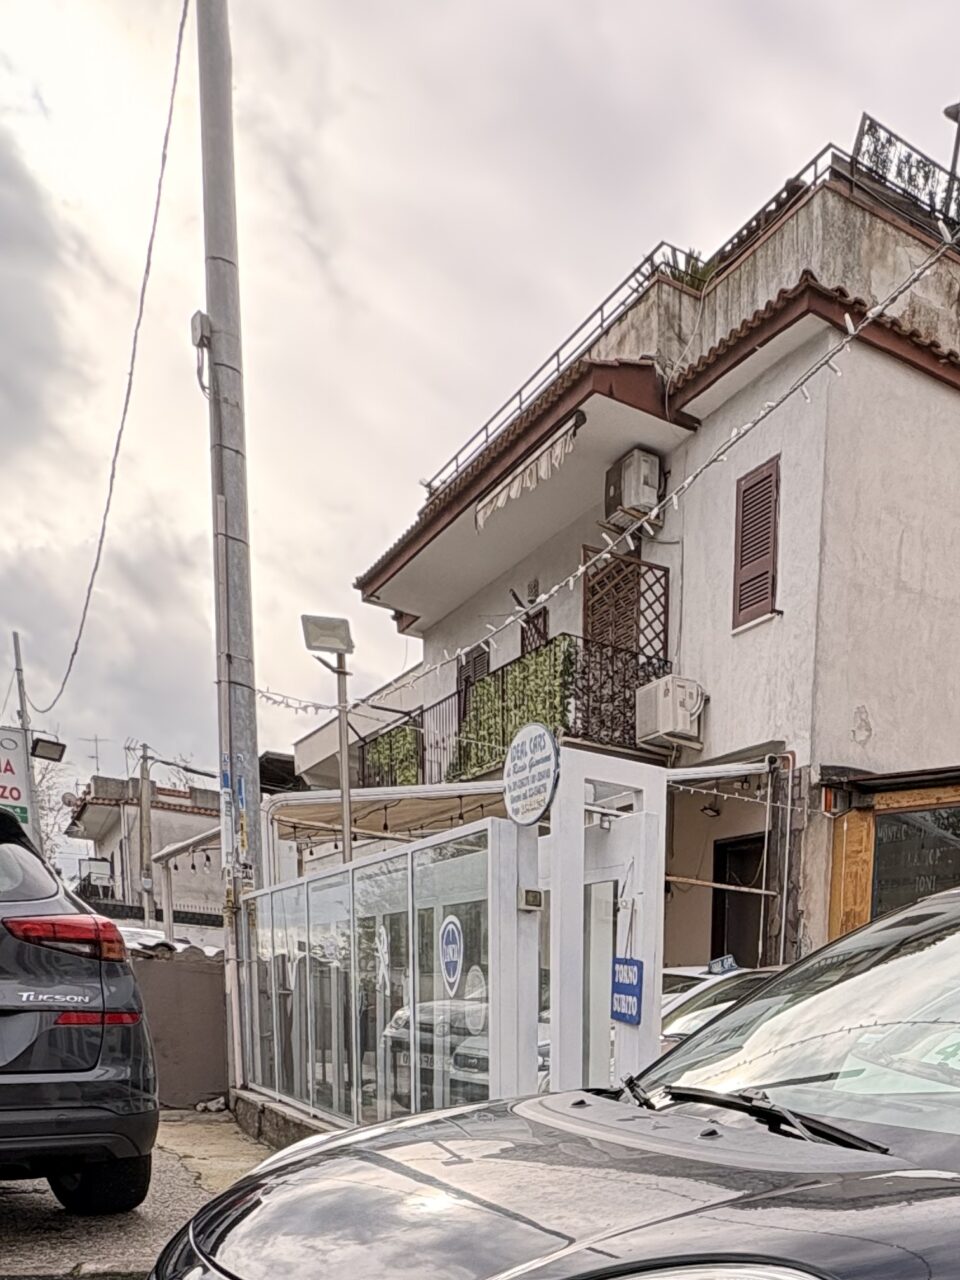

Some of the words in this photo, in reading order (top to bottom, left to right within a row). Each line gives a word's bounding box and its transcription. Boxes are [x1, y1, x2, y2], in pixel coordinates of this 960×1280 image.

[0, 758, 16, 776] A
[614, 963, 638, 986] TORNO
[17, 991, 90, 1003] TUCSON
[613, 992, 638, 1017] SUBITO
